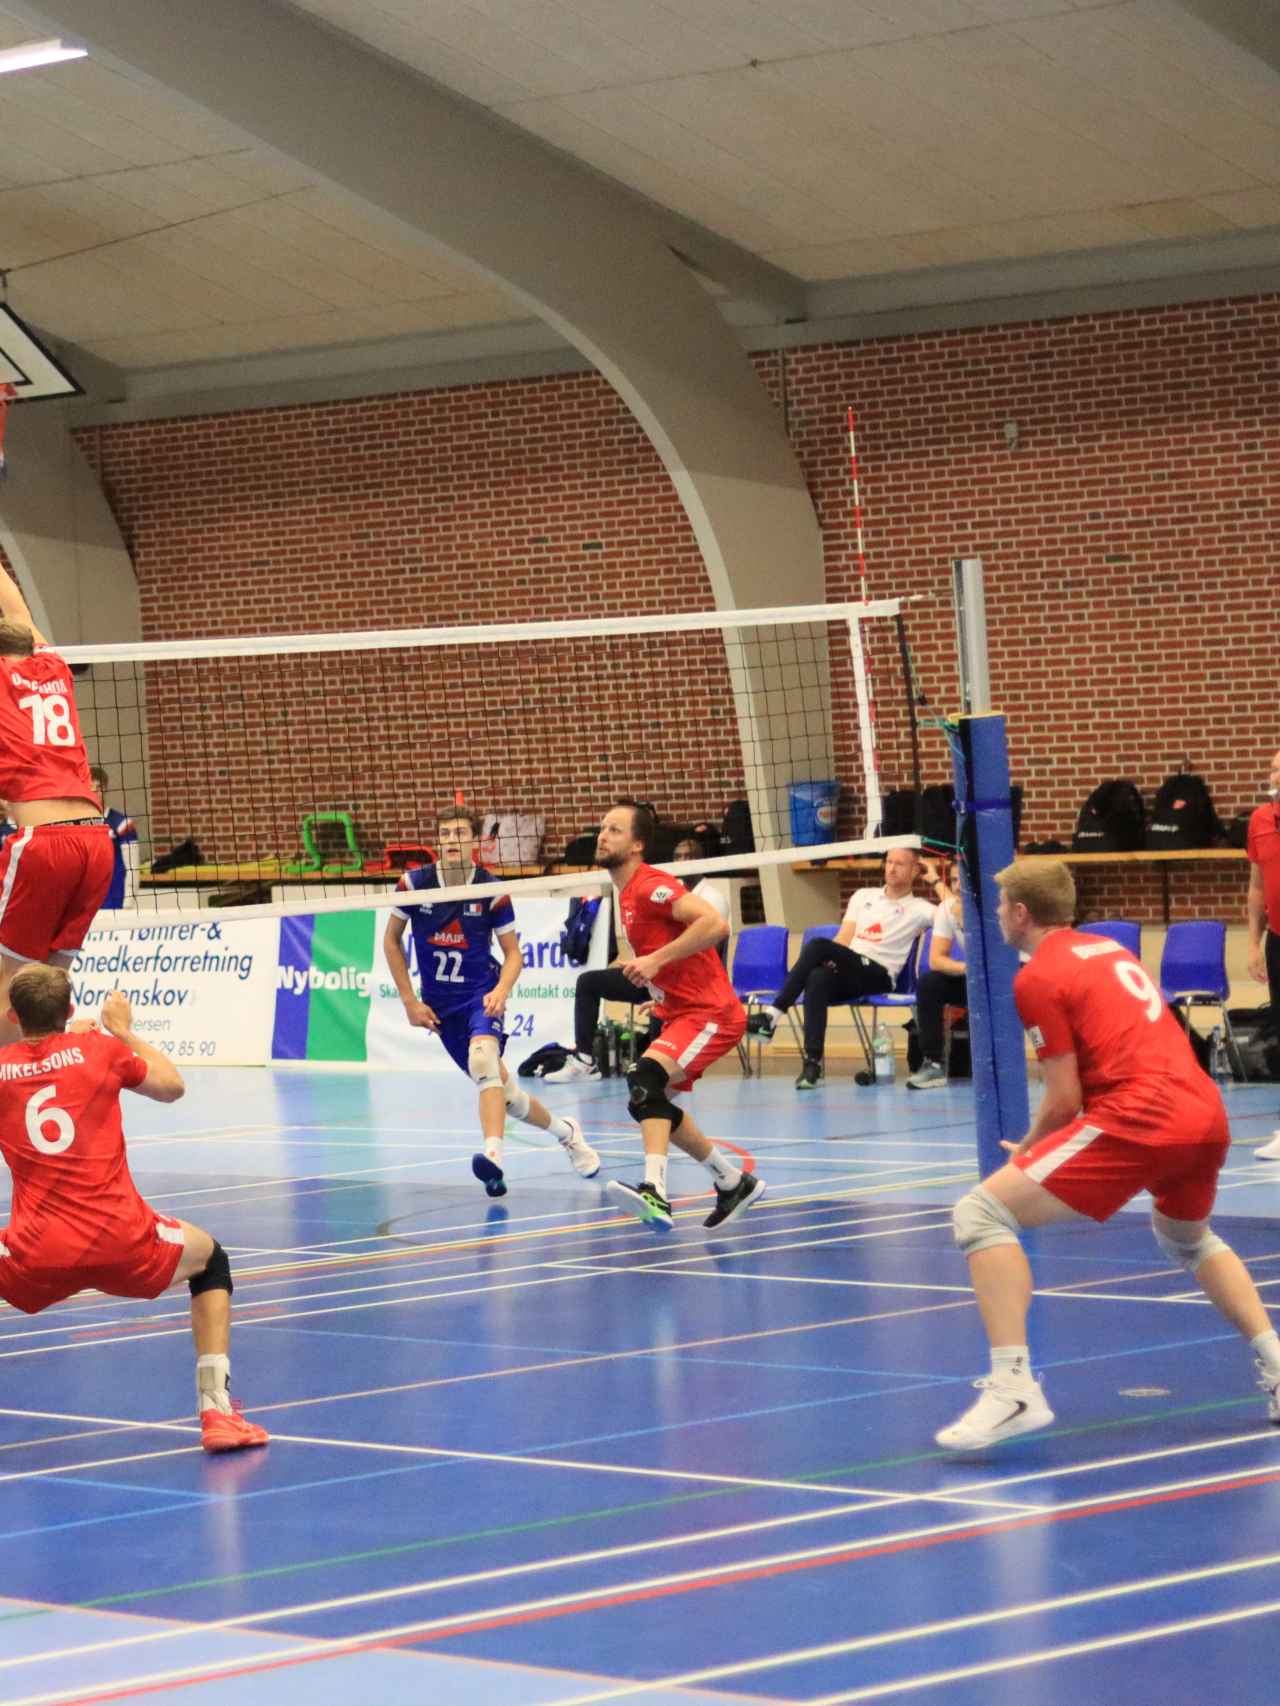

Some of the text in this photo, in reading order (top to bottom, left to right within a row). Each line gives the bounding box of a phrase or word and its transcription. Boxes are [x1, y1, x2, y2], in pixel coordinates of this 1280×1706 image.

[19, 694, 76, 746] 18
[434, 932, 465, 944] MAIF
[72, 944, 253, 980] Snedkerforretning
[433, 951, 465, 982] 22
[275, 965, 371, 998] Nybolig
[517, 983, 560, 998] kontakt
[1114, 961, 1161, 1022] 9
[510, 1013, 535, 1036] 24
[25, 1085, 75, 1155] 6
